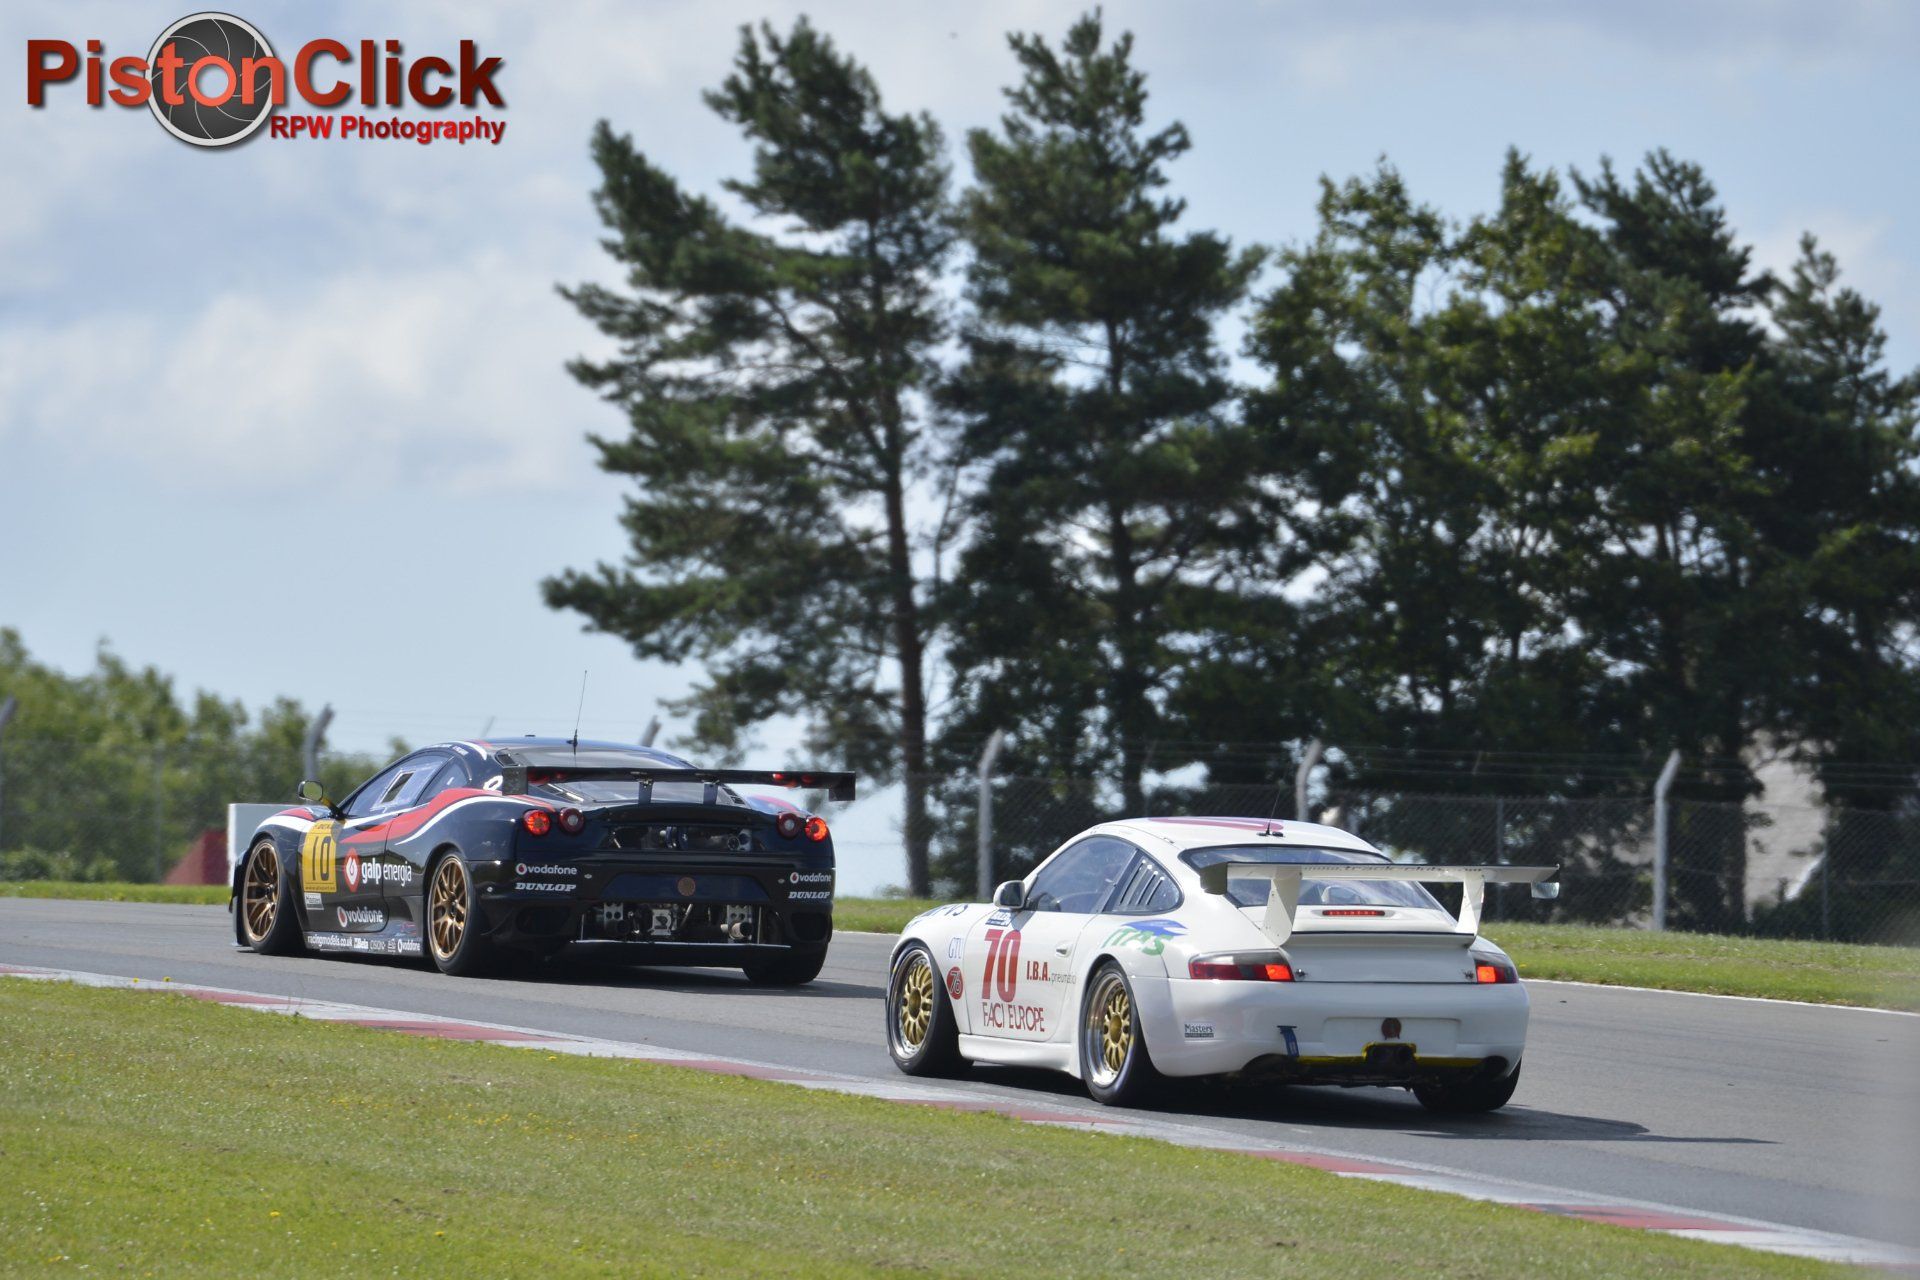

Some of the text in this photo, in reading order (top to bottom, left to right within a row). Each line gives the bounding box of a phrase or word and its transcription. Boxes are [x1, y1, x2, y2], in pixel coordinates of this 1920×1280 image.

[312, 836, 332, 881] 10
[361, 857, 412, 887] galp energia
[527, 865, 577, 875] vodafone
[799, 872, 832, 882] vodafone
[515, 882, 577, 892] DUNLOP
[788, 891, 831, 899] DUNLOP
[346, 906, 383, 923] vodafone
[981, 928, 1021, 1003] 70
[1008, 1004, 1045, 1032] EUROPE
[1184, 1023, 1214, 1033] Masters
